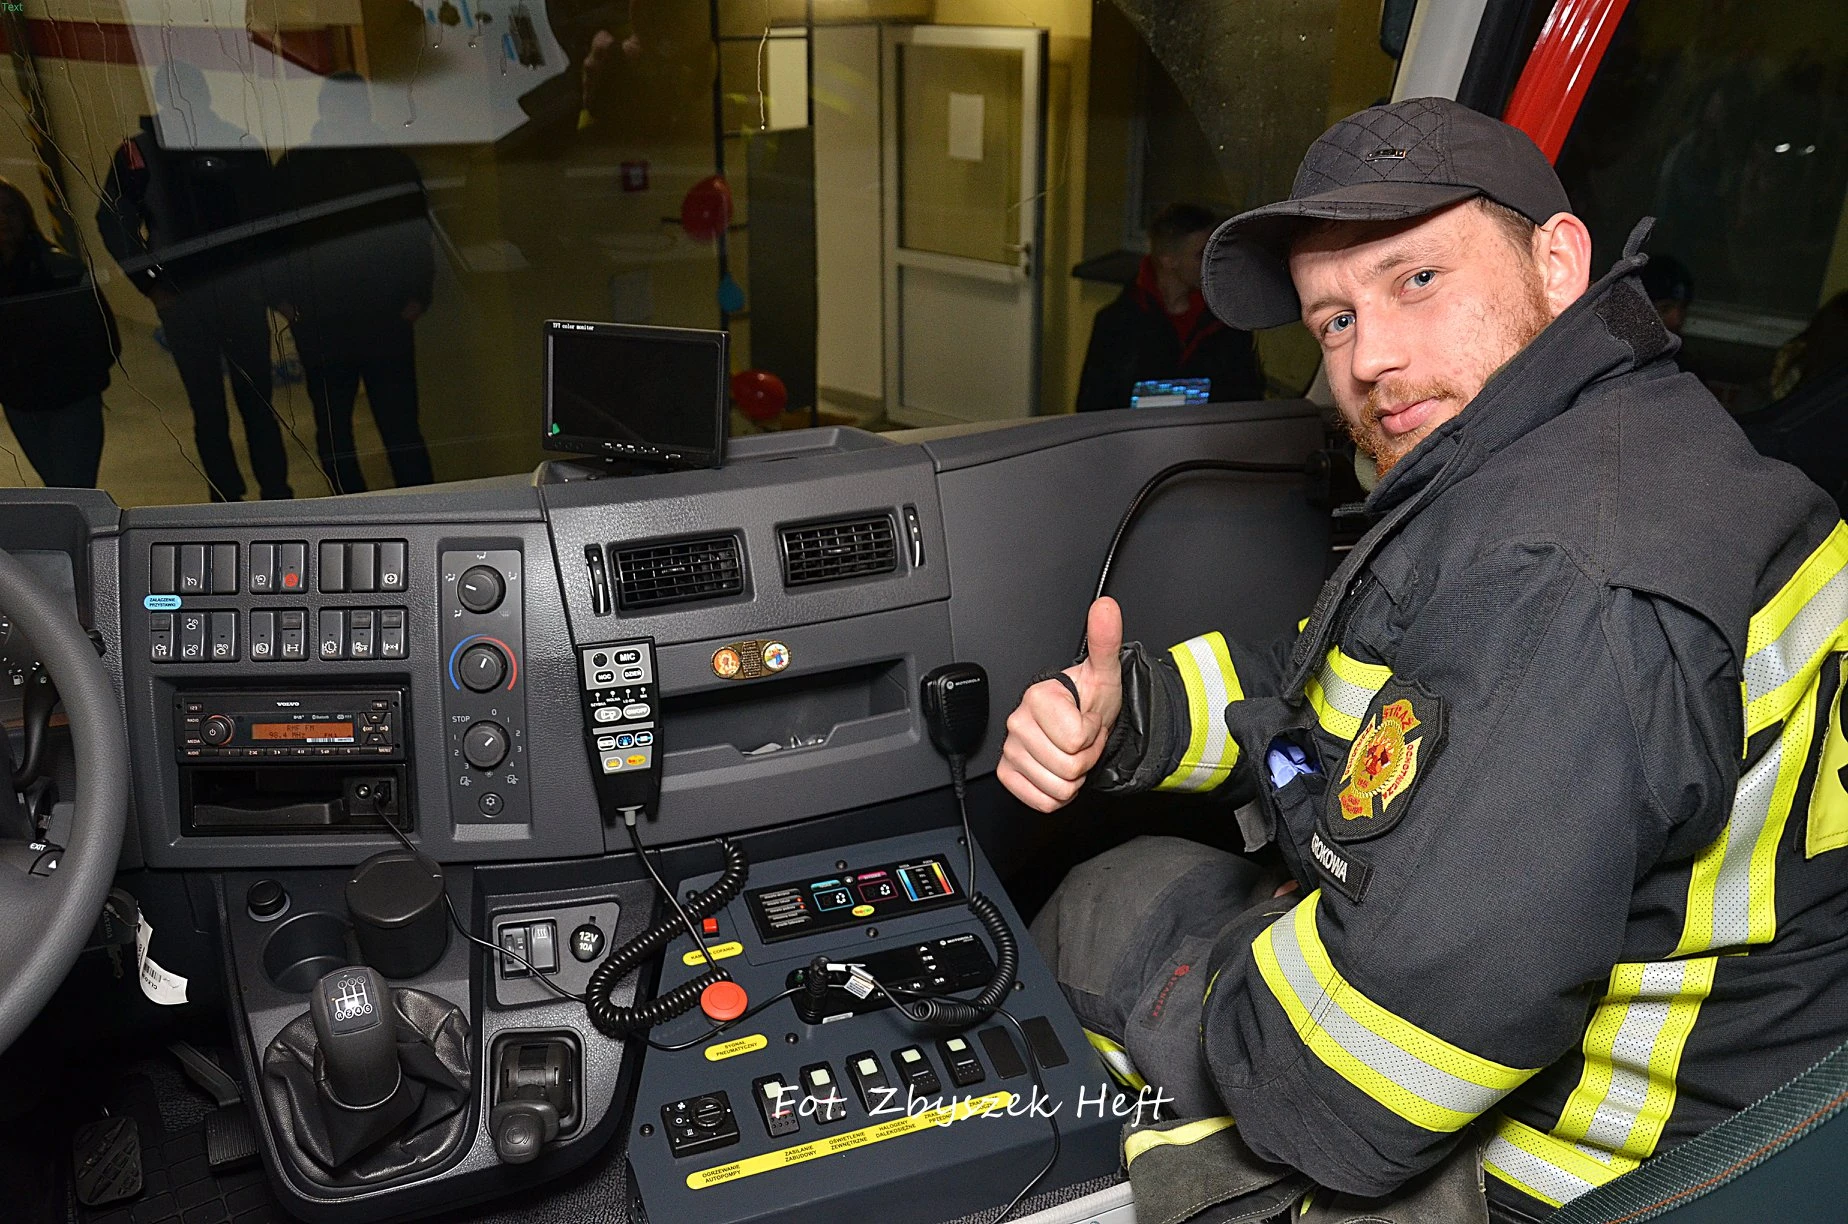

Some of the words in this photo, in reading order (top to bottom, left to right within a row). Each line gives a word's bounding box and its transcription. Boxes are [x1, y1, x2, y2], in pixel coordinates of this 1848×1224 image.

[619, 652, 636, 662] MIC
[491, 708, 497, 716] 0
[451, 715, 471, 723] STOP
[515, 729, 521, 737] 2
[454, 749, 460, 757] 2
[517, 745, 522, 753] 3
[464, 762, 470, 770] 3
[1382, 744, 1414, 800] OCHOTNICZA
[29, 842, 47, 851] EXIT
[578, 931, 599, 943] 12V
[578, 942, 594, 952] 10A
[712, 946, 735, 955] COFANIA
[716, 1042, 758, 1057] PNEUMATYCZNY
[724, 1040, 747, 1049] SYGNAŁ
[875, 1123, 916, 1139] DALEKOSIĘŻNE
[878, 1119, 908, 1132] HALOGENY
[828, 1130, 866, 1145] OŚWIETLENIE
[831, 1136, 868, 1151] ZEWNĘTRZNE
[784, 1144, 814, 1157] ZASILANIE
[784, 1150, 817, 1163] ZABUDOWY
[702, 1163, 741, 1178] OGRZEWANIE
[704, 1169, 741, 1184] AUTOPOMPY
